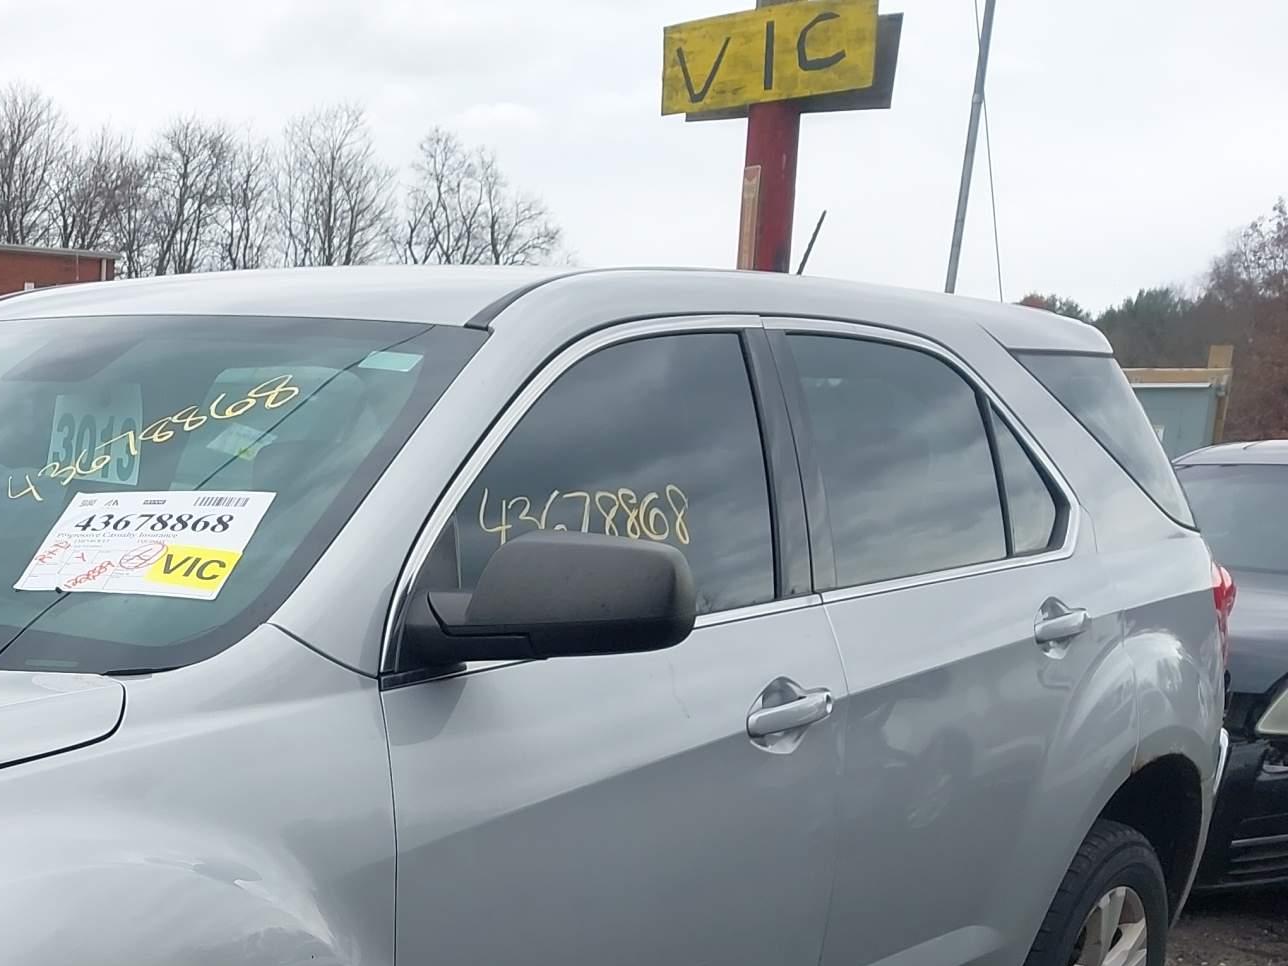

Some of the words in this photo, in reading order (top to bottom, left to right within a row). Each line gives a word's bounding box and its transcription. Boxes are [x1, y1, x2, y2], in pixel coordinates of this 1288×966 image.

[676, 11, 847, 104] VIC
[74, 513, 235, 534] 43678868
[162, 553, 227, 582] VIC
